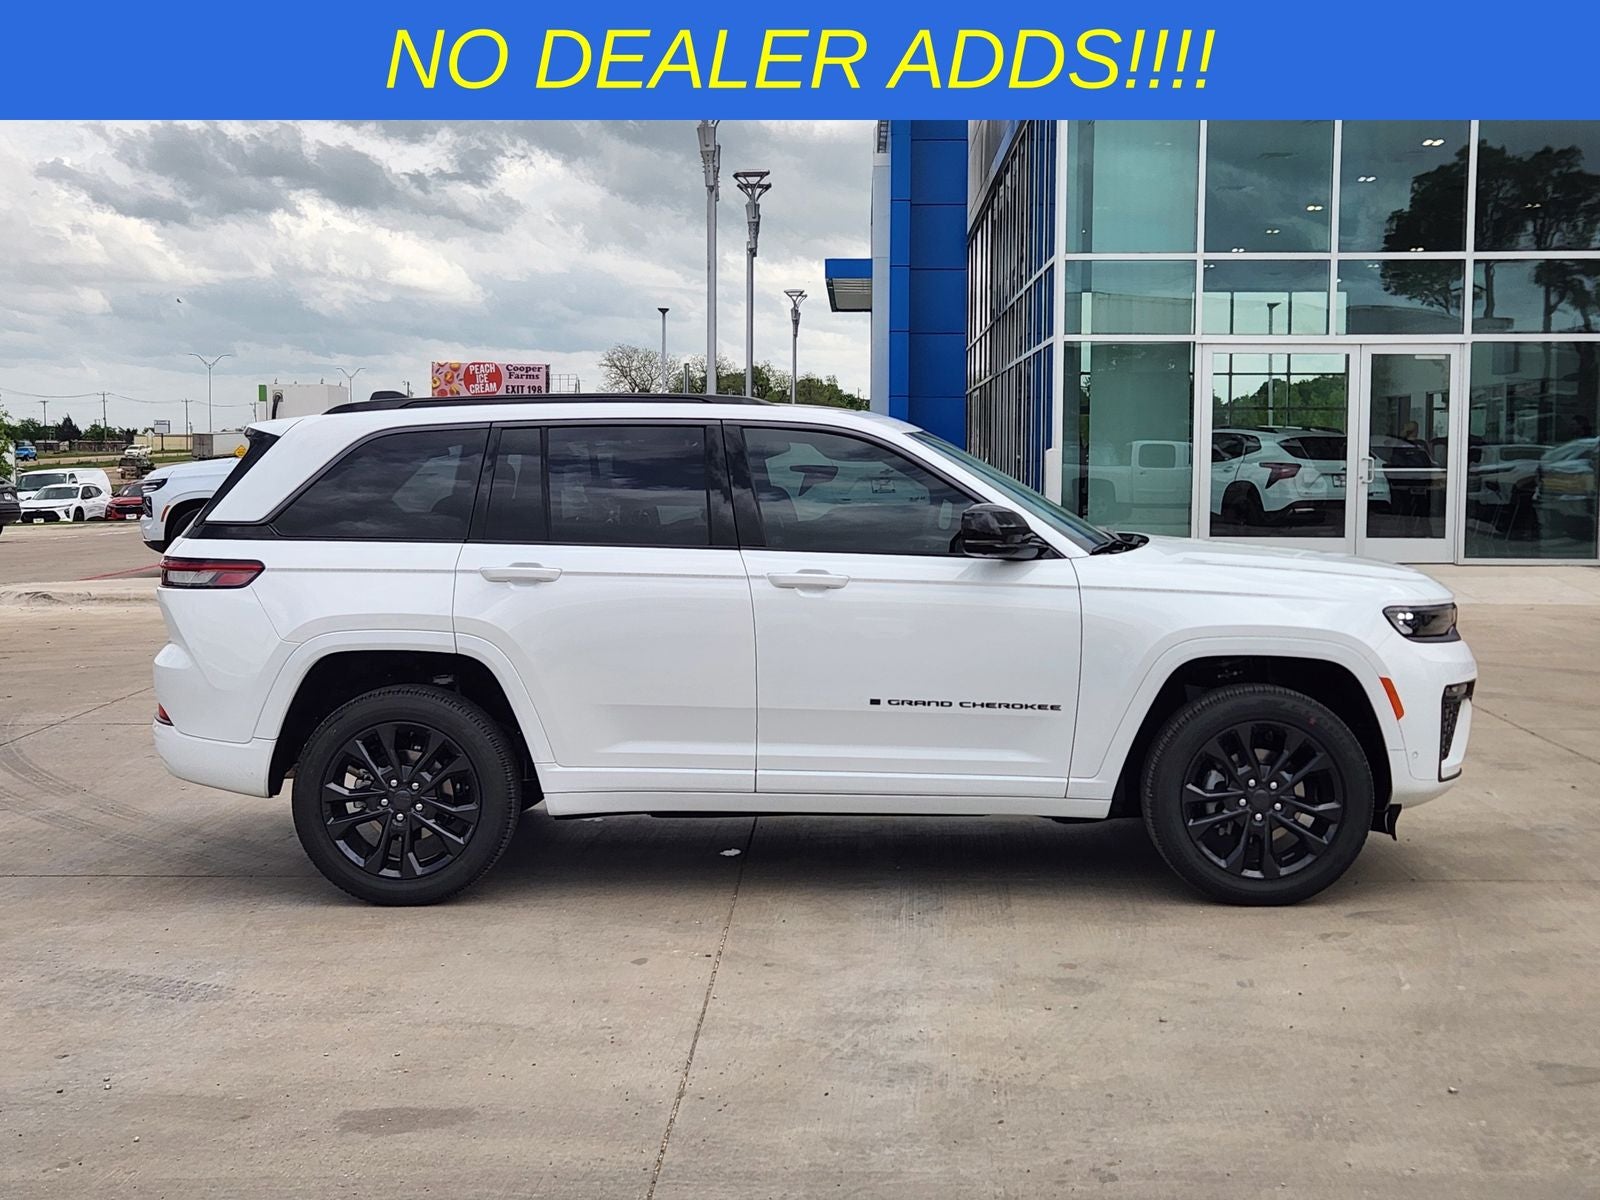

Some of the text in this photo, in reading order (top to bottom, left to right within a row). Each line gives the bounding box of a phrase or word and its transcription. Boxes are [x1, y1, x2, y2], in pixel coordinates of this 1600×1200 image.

[469, 363, 496, 375] PEACH
[505, 364, 543, 374] Cooper
[476, 374, 489, 384] ICE
[508, 371, 540, 380] Farms
[469, 383, 497, 394] CREAM
[505, 385, 543, 394] EXIT 198
[888, 699, 1062, 711] GRAND CHEROKEE
